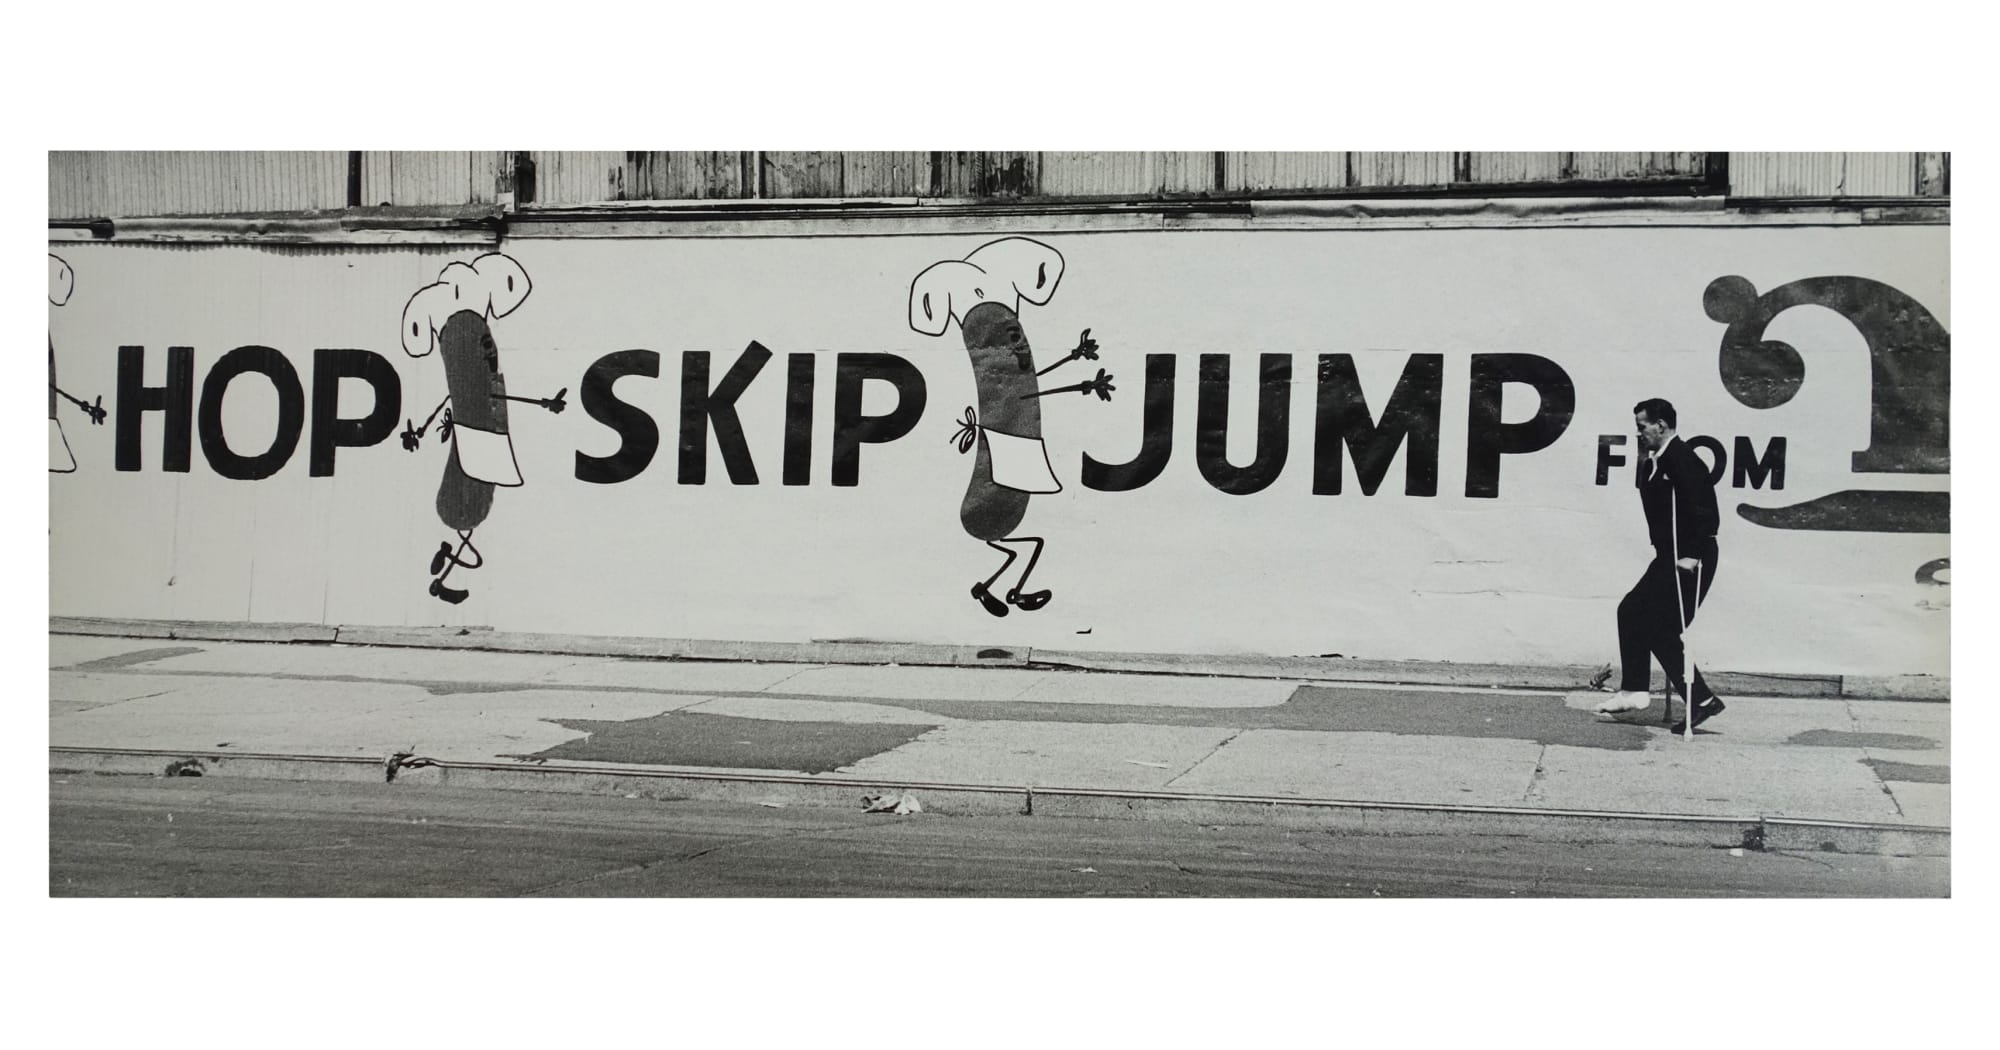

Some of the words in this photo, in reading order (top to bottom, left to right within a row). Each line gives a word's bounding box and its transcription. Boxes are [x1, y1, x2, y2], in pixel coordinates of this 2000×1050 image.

[115, 345, 402, 481] HOP
[574, 340, 927, 487] SKIP
[1081, 353, 1576, 499] JUMP
[1595, 434, 1788, 491] FOM
